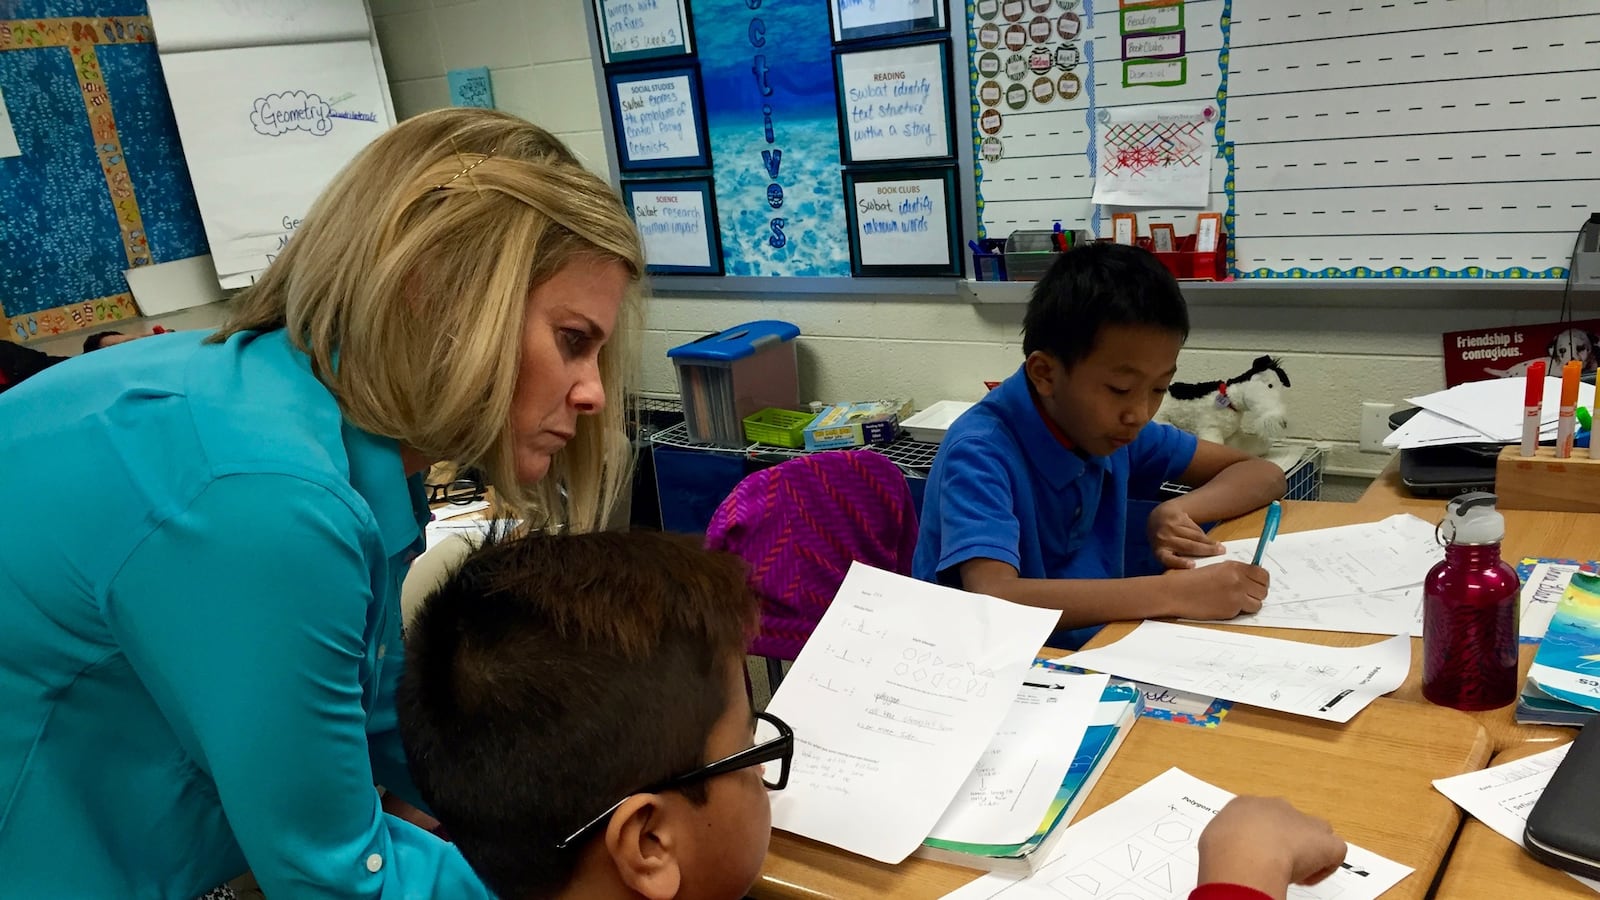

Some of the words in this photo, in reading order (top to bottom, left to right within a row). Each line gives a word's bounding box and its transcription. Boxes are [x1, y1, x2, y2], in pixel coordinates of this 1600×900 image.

[667, 28, 677, 44] 3
[873, 71, 906, 82] READING
[631, 85, 651, 94] SOCIAL
[651, 82, 675, 92] STUDIES
[260, 101, 326, 132] Geometry
[853, 104, 874, 124] text
[903, 121, 938, 147] story
[877, 187, 898, 195] BOOK
[898, 185, 921, 194] CLUBS
[656, 195, 679, 204] SCIENCE
[1457, 332, 1511, 348] Friendship
[1514, 331, 1524, 344] is
[1462, 347, 1523, 361] contagious.
[1181, 795, 1212, 813] Polygon
